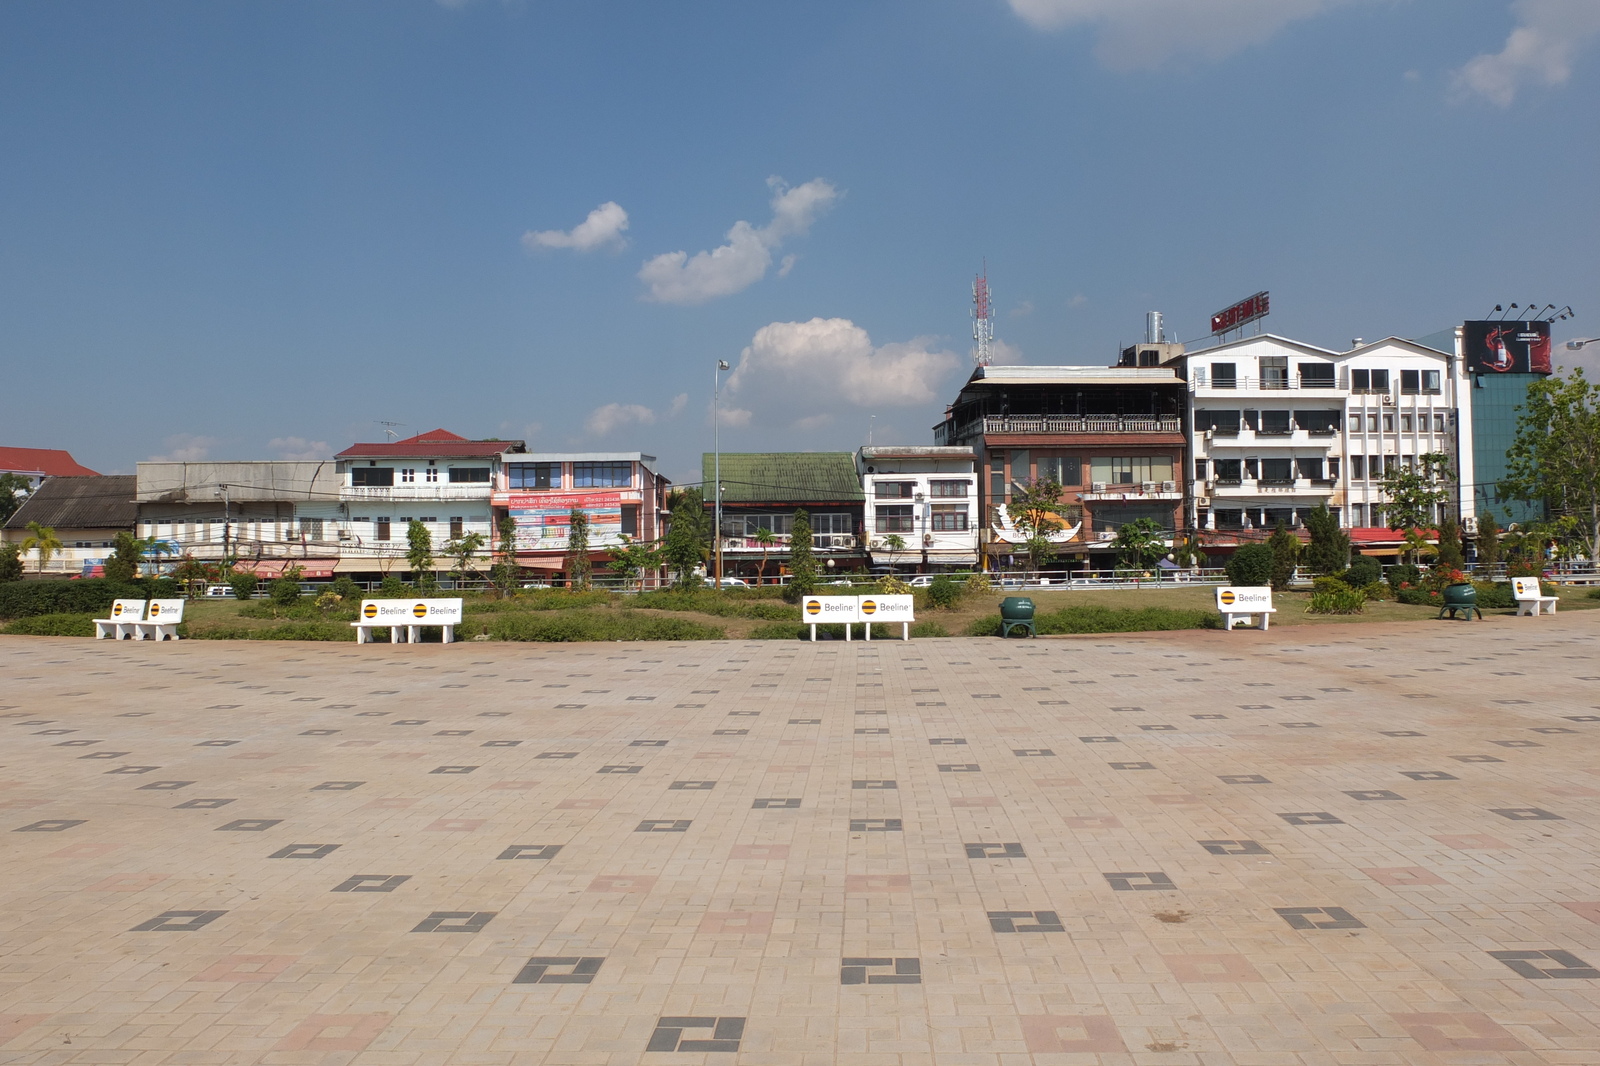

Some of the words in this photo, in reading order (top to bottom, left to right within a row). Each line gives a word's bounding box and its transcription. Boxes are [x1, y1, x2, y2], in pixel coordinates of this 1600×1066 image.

[1238, 594, 1266, 602] Beeline
[380, 606, 406, 614] Beeline
[430, 606, 456, 614] Beeline
[825, 603, 853, 612] Beeline
[880, 603, 908, 612] Beeline
